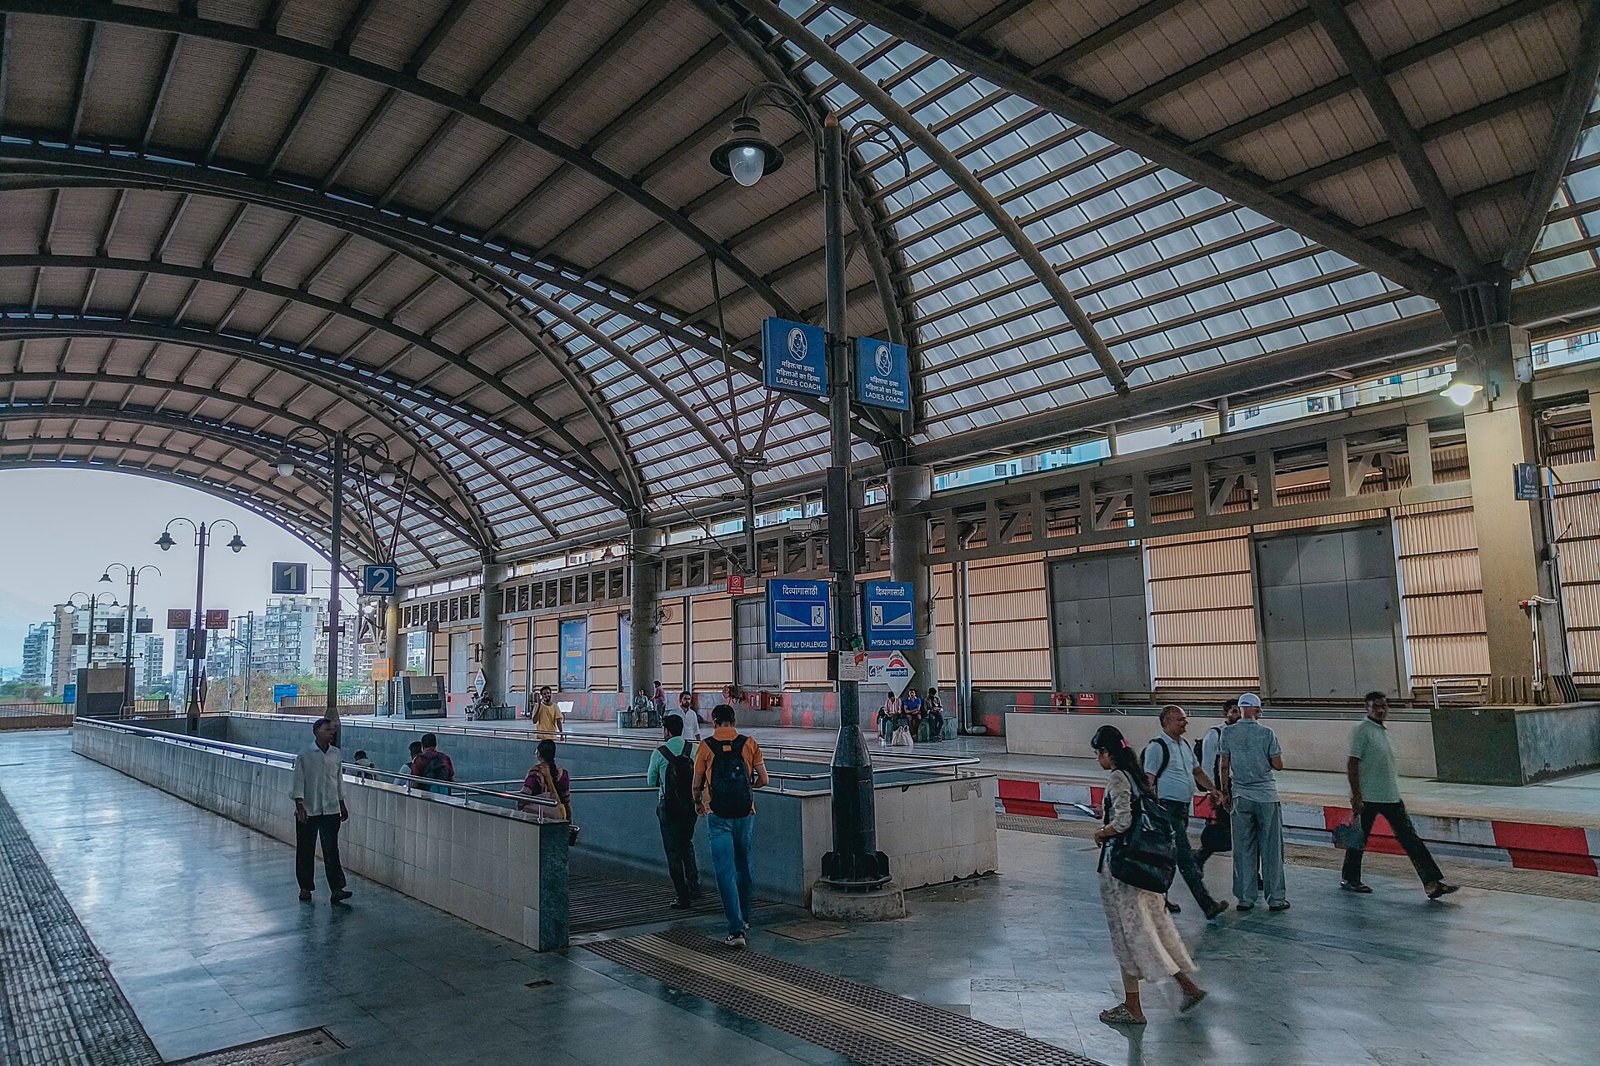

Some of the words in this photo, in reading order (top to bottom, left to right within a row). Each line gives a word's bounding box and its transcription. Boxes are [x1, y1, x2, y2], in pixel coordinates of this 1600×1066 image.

[775, 376, 799, 387] LADIES
[799, 380, 822, 391] COACH
[865, 391, 885, 401] LADIES
[885, 395, 905, 405] COACH
[283, 565, 298, 590] 1
[372, 568, 390, 592] 2
[774, 641, 800, 649] PHYSICALLY
[800, 640, 828, 649] CHALLENGED
[871, 639, 892, 647] PHYSICALLY
[892, 638, 914, 647] CHALLENGED
